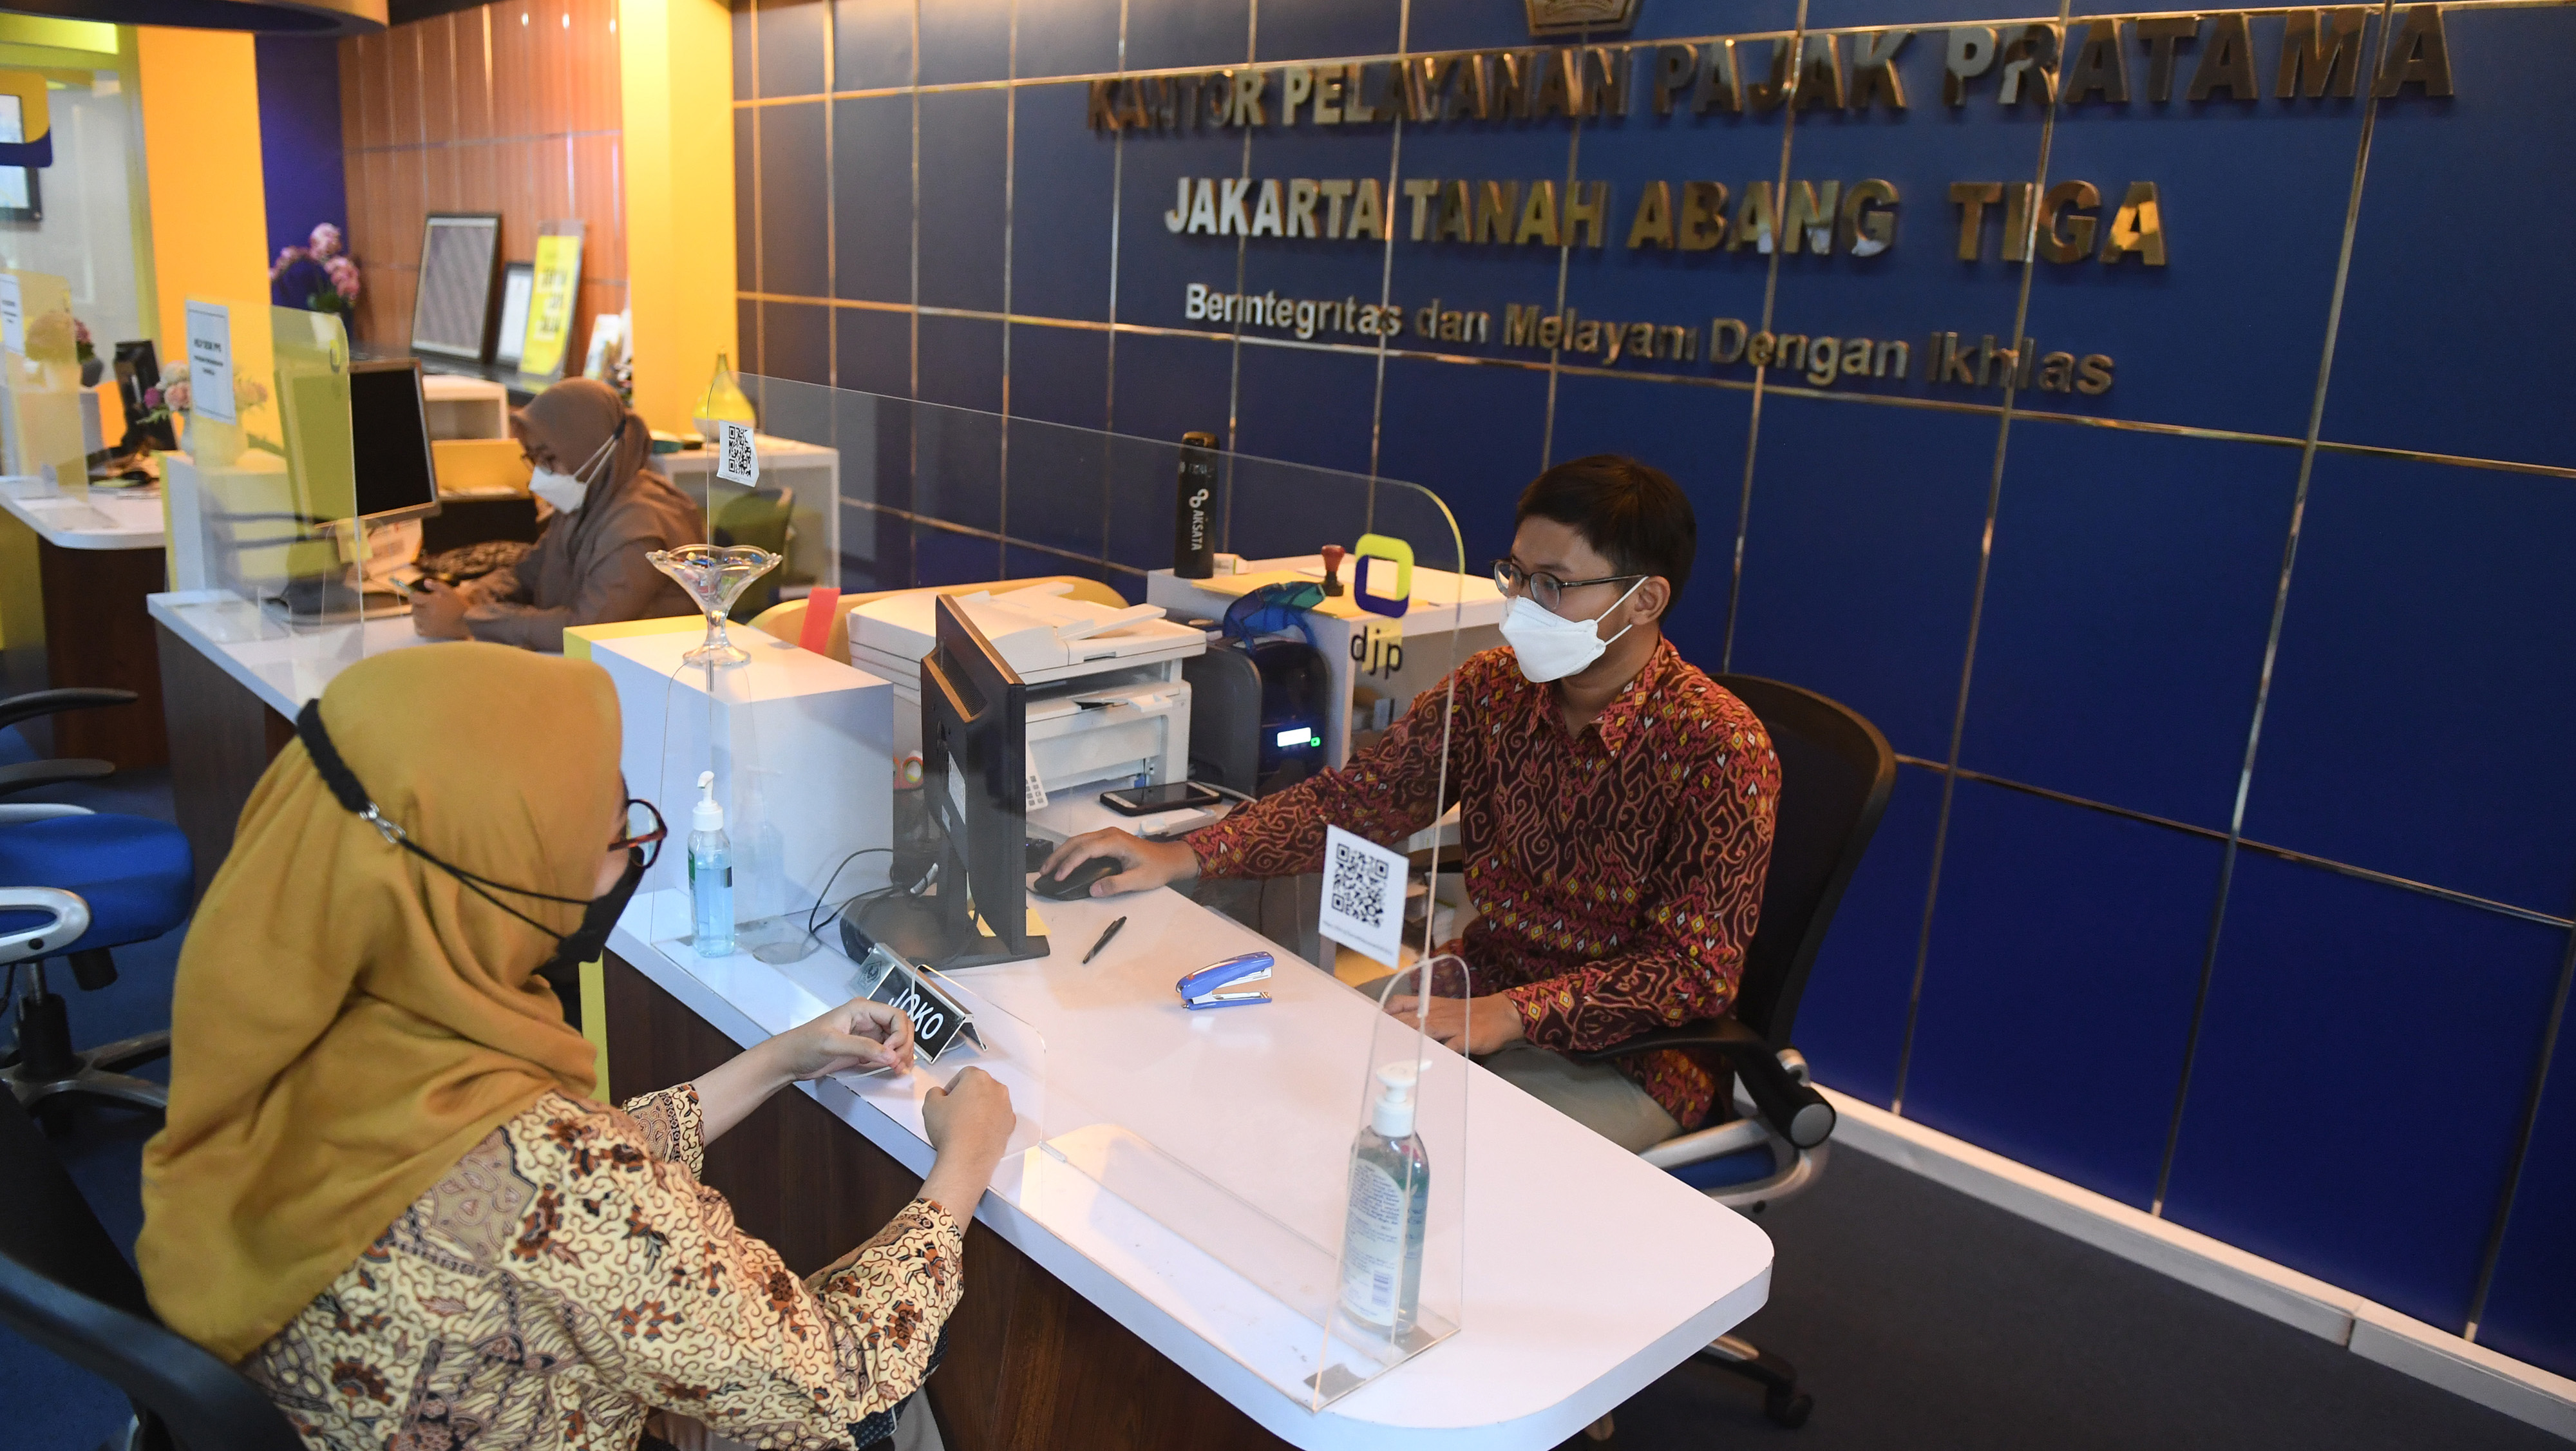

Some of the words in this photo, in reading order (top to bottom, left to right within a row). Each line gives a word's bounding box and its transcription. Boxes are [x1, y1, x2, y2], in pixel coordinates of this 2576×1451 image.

[1088, 68, 1267, 129] KANTOR
[1283, 46, 1628, 126] PELAYANAN
[1652, 30, 1915, 115] PAJAK
[1944, 5, 2454, 107] PRATAMA
[1164, 177, 1386, 241] JAKARTA
[1404, 178, 1607, 247] TANAH
[1626, 178, 1899, 257] ABANG
[1949, 180, 2167, 266] TIGA
[1184, 282, 1403, 340] Berintegritas
[1416, 298, 1488, 343] dan
[1502, 303, 1698, 365] Melayani
[1709, 318, 1909, 386] Dengan
[1926, 331, 2115, 396] Ikhlas
[1190, 509, 1207, 552] AKSATA
[1350, 625, 1403, 679] djp
[889, 987, 944, 1040] JOKO
